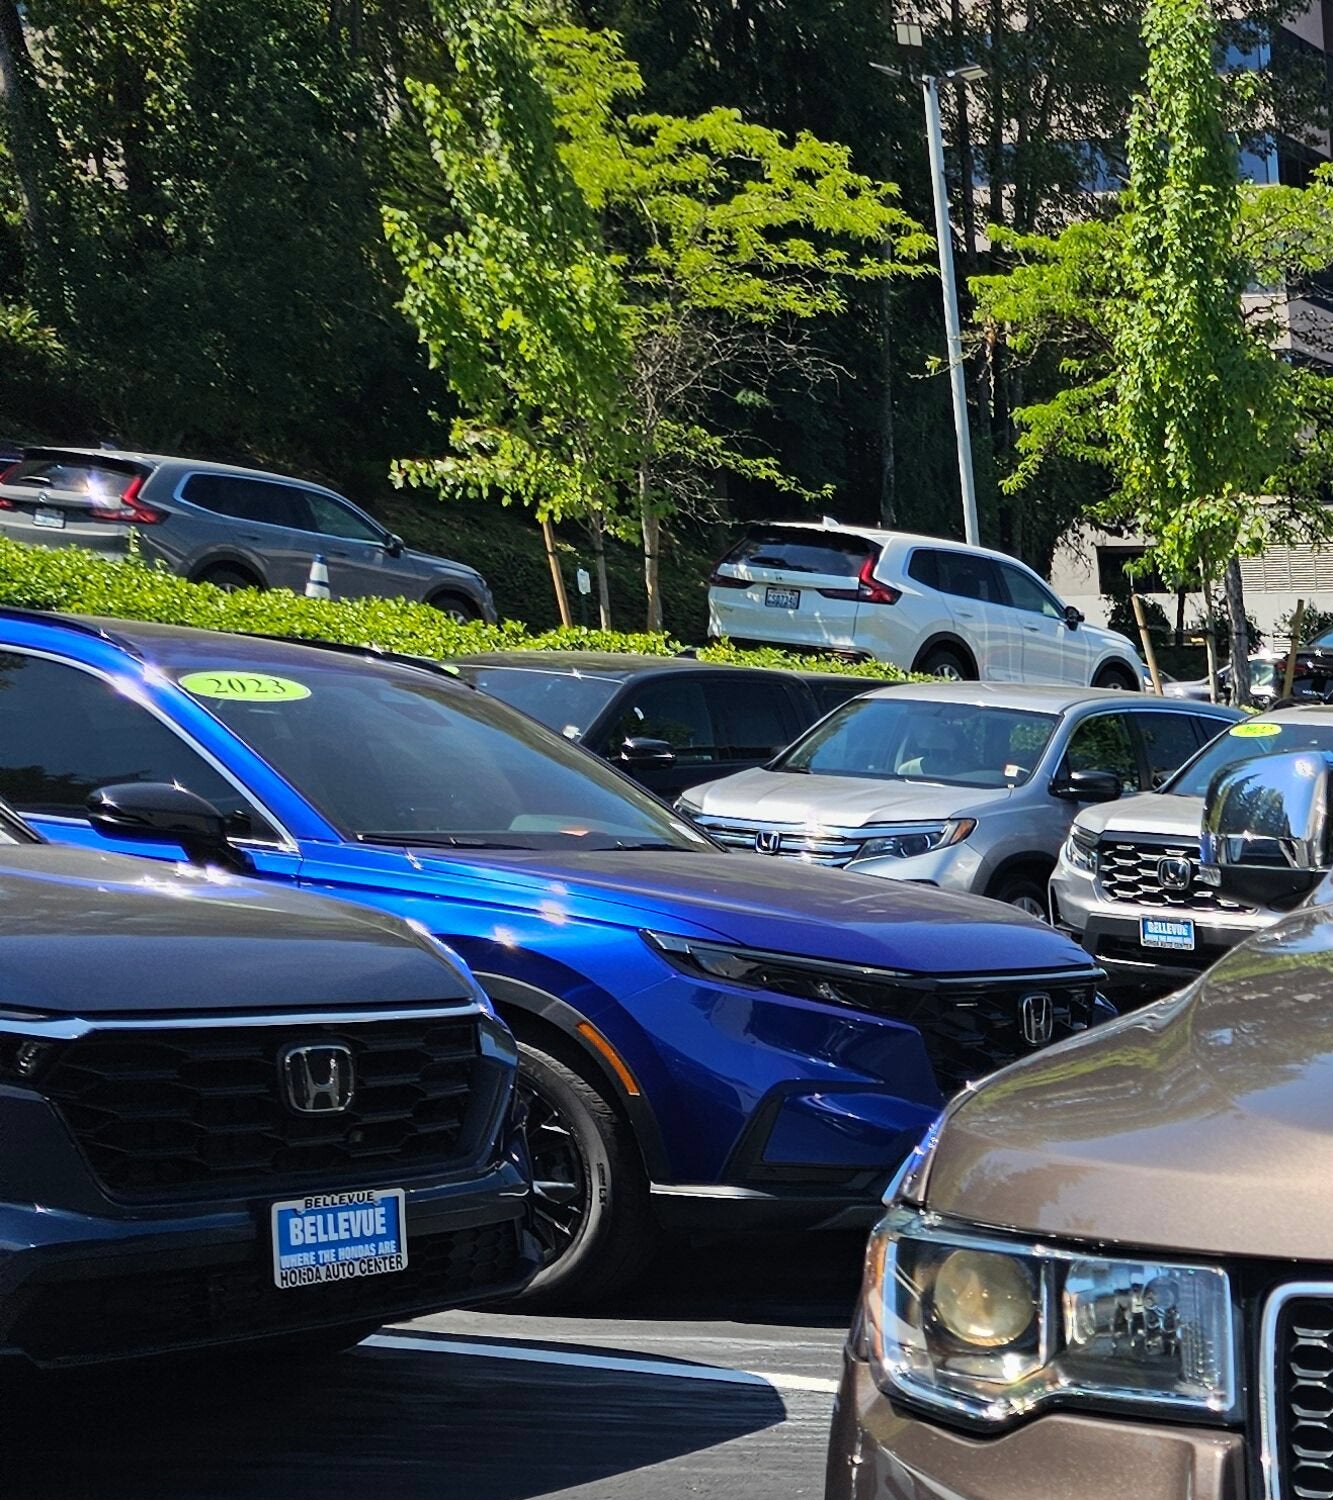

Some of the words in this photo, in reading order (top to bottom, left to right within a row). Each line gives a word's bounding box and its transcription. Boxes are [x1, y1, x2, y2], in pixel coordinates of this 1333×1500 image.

[207, 678, 286, 694] 2023
[304, 1191, 375, 1209] BELLEVUE
[289, 1207, 387, 1246] BELLEVUE
[280, 1251, 316, 1269] WHERE
[318, 1249, 337, 1262] THE
[338, 1244, 376, 1261] HONDAS
[378, 1240, 397, 1254] ARE
[280, 1266, 322, 1287] HONDA
[325, 1261, 355, 1279] AUTO
[359, 1255, 403, 1275] CENTER
